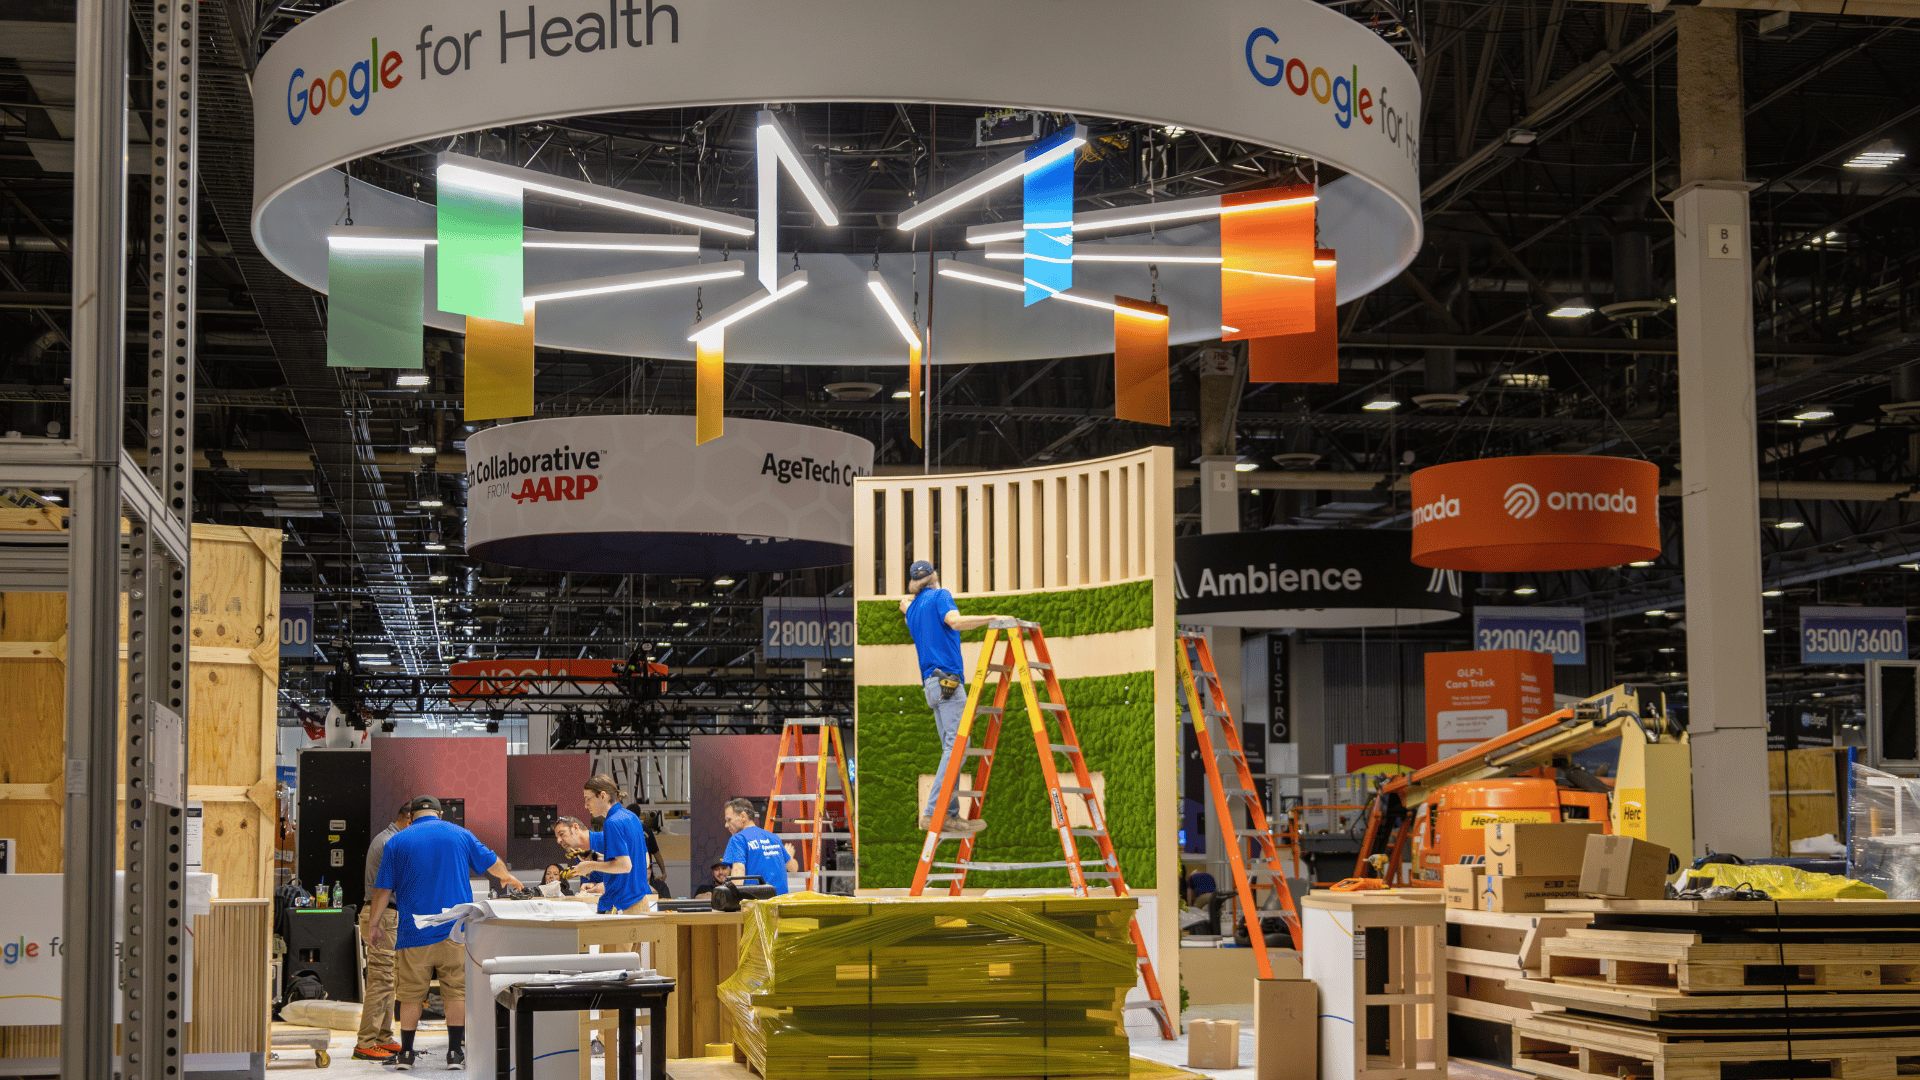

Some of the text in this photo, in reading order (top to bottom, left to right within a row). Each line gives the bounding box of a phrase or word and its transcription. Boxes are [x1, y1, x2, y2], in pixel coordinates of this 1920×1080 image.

[287, 0, 680, 126] Google for Health
[1245, 27, 1373, 129] Google
[1379, 86, 1402, 148] for
[1720, 228, 1728, 239] B
[1721, 243, 1728, 254] 6
[761, 453, 839, 484] AgeTech
[1547, 488, 1637, 514] omada
[1197, 562, 1362, 598] Ambience
[1480, 629, 1580, 654] 3200/3400
[1806, 628, 1903, 653] 3500/3600
[1445, 678, 1496, 689] Care Track
[1456, 667, 1484, 678] GLP-1
[1272, 640, 1287, 738] BISTRO
[1623, 806, 1642, 821] Herc
[0, 935, 39, 965] gle
